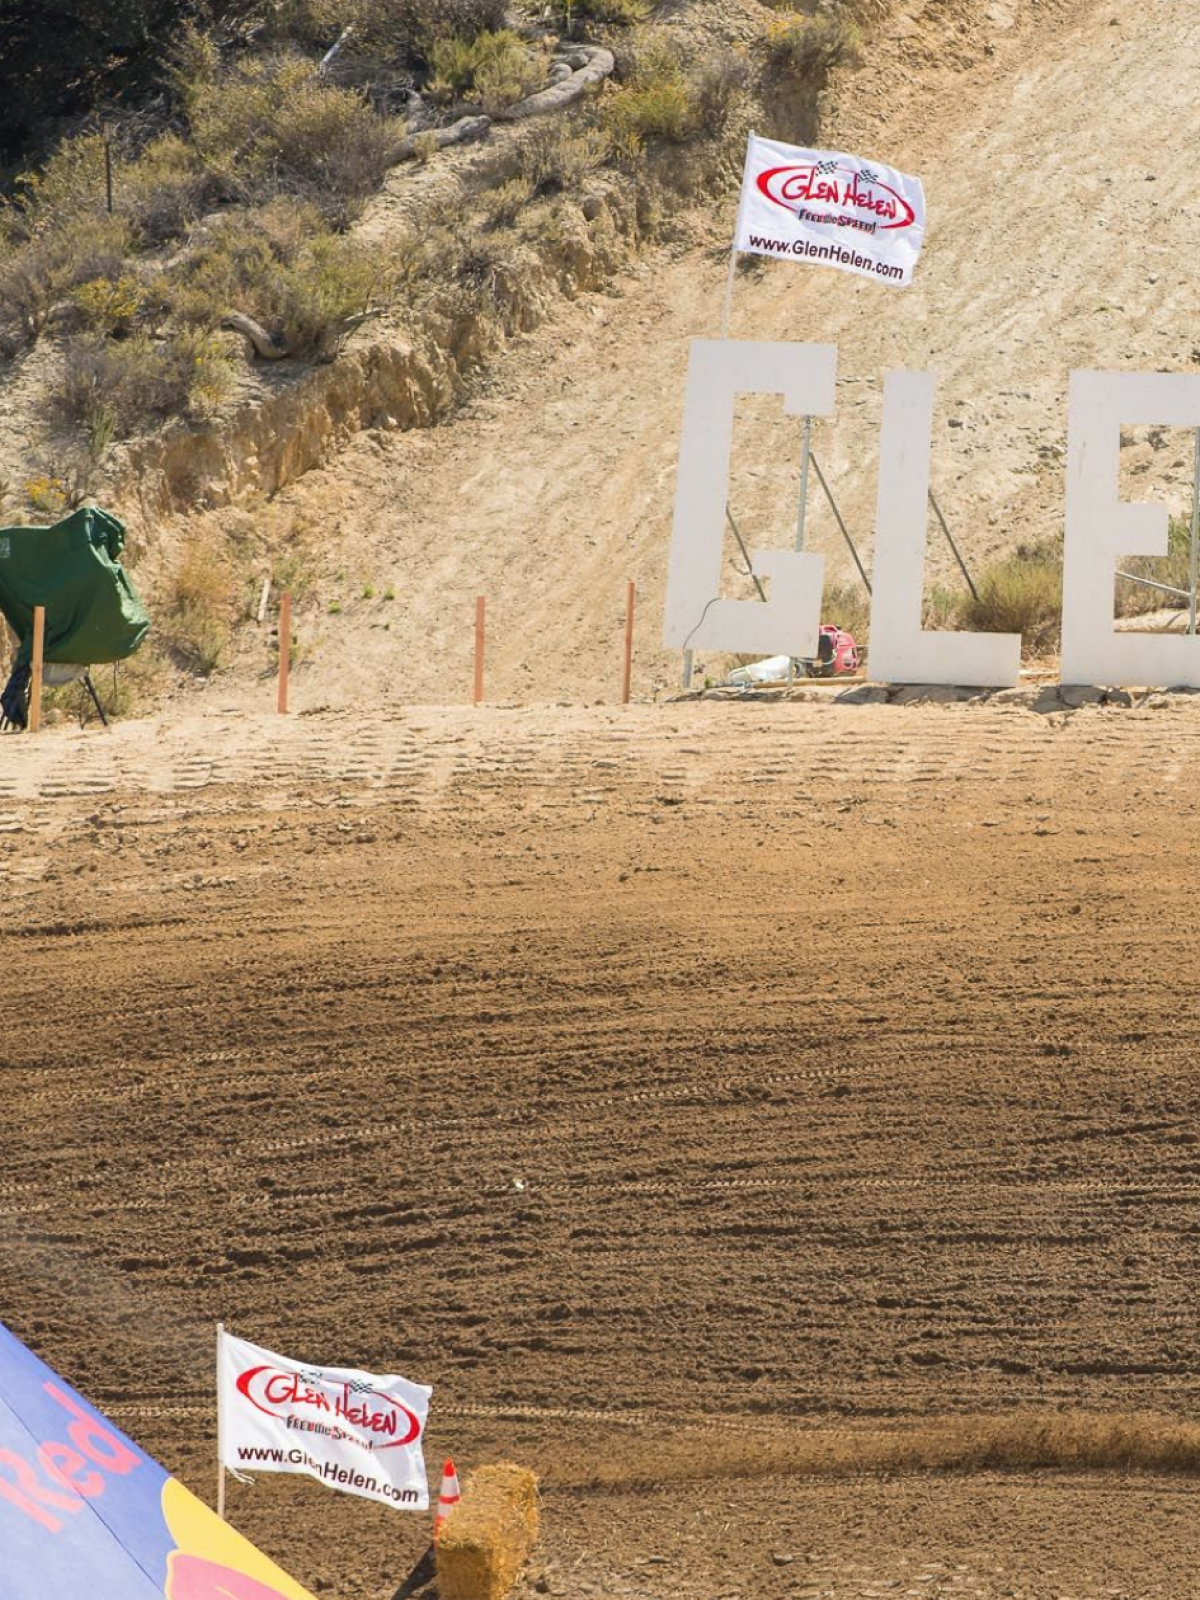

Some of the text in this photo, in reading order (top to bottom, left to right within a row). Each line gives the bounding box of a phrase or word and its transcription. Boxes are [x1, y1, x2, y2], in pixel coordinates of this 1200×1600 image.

[781, 166, 896, 219] GLEN HELEN
[749, 235, 904, 280] www.GlenHelen.com
